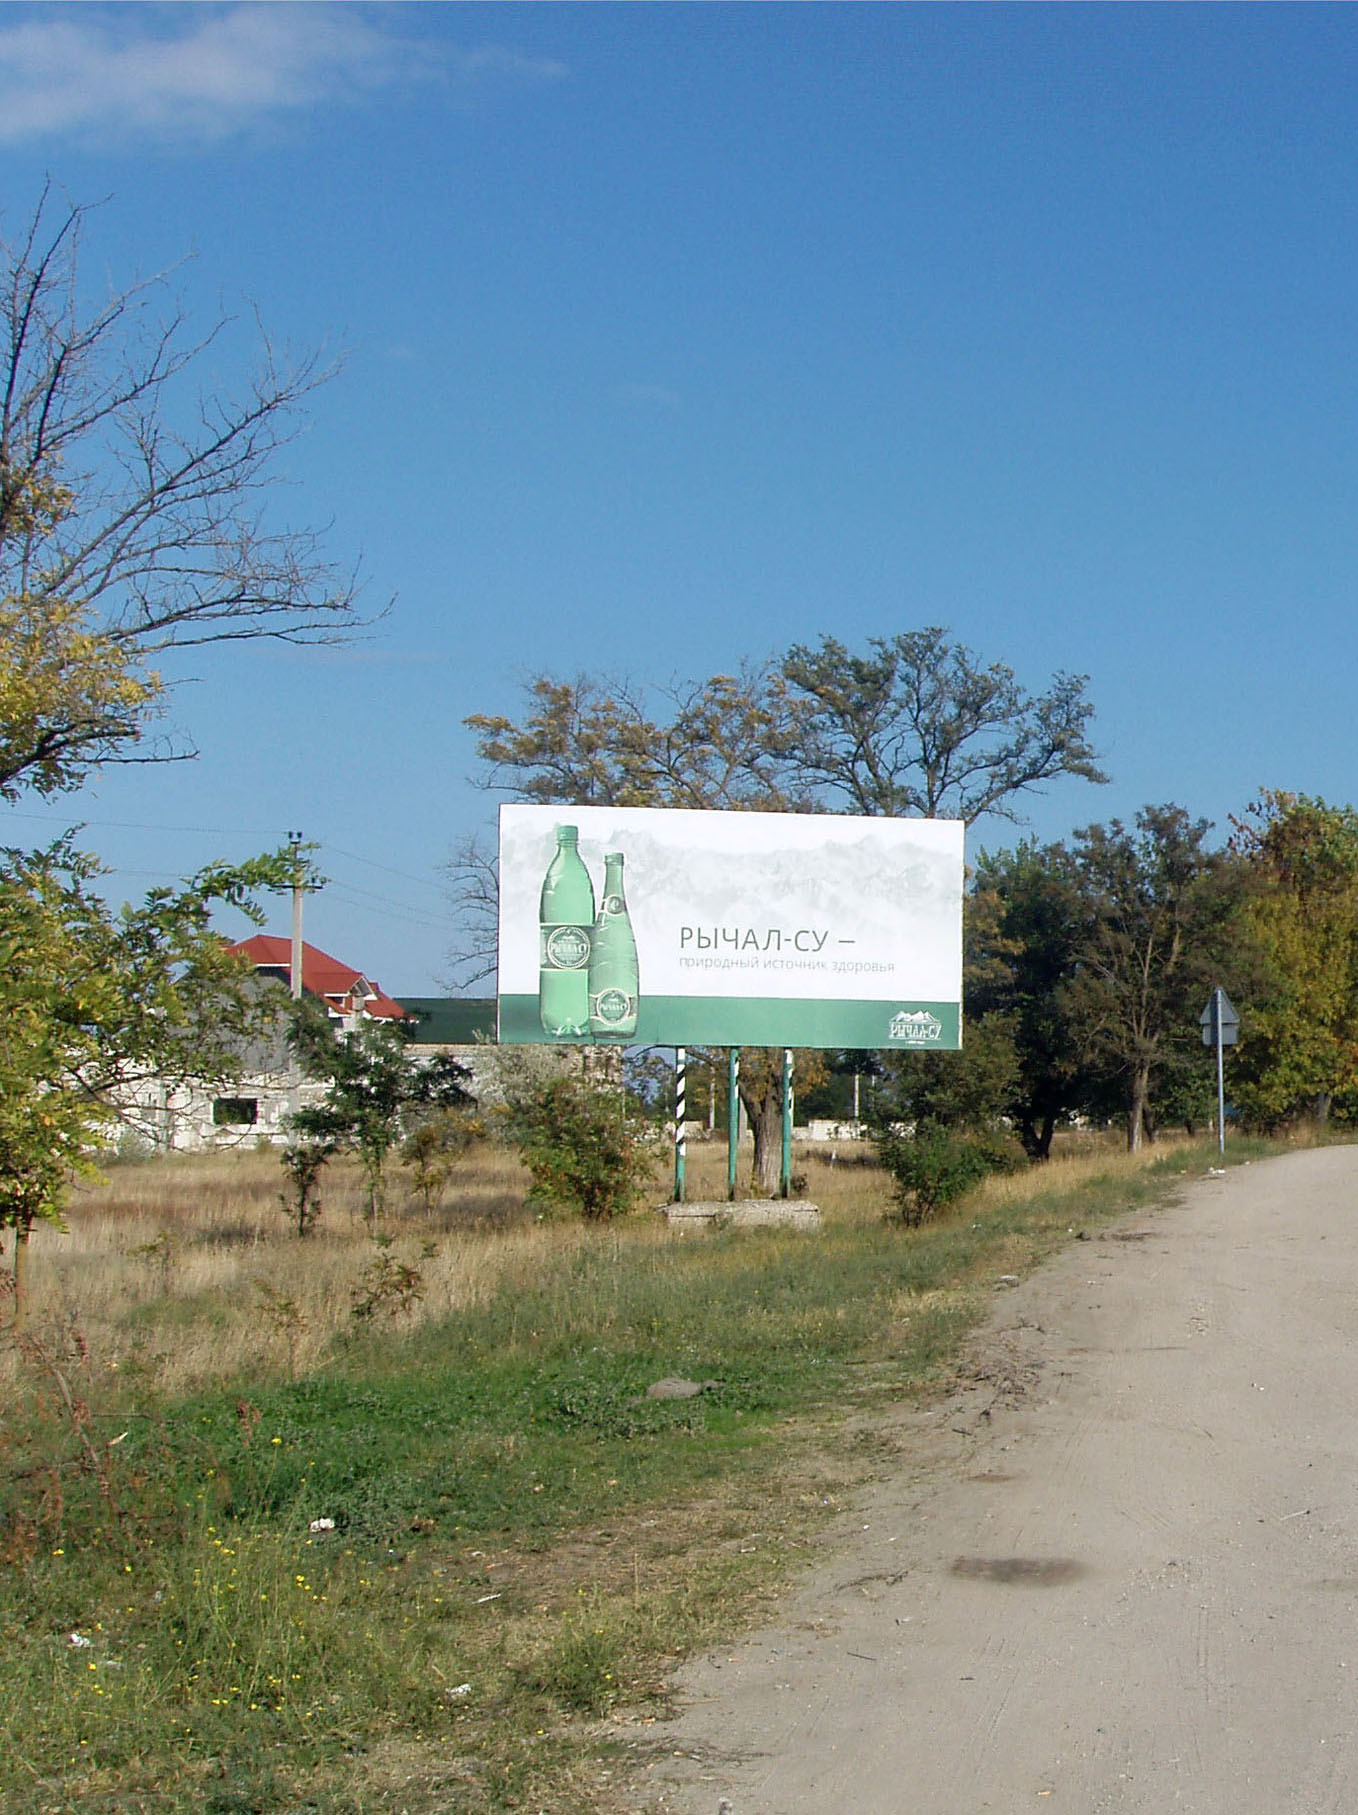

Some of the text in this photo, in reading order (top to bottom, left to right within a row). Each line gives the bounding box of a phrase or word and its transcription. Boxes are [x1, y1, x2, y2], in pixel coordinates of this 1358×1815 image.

[680, 926, 829, 952] РЫЧАЛ-СУ
[679, 956, 895, 975] природный источник здоровья
